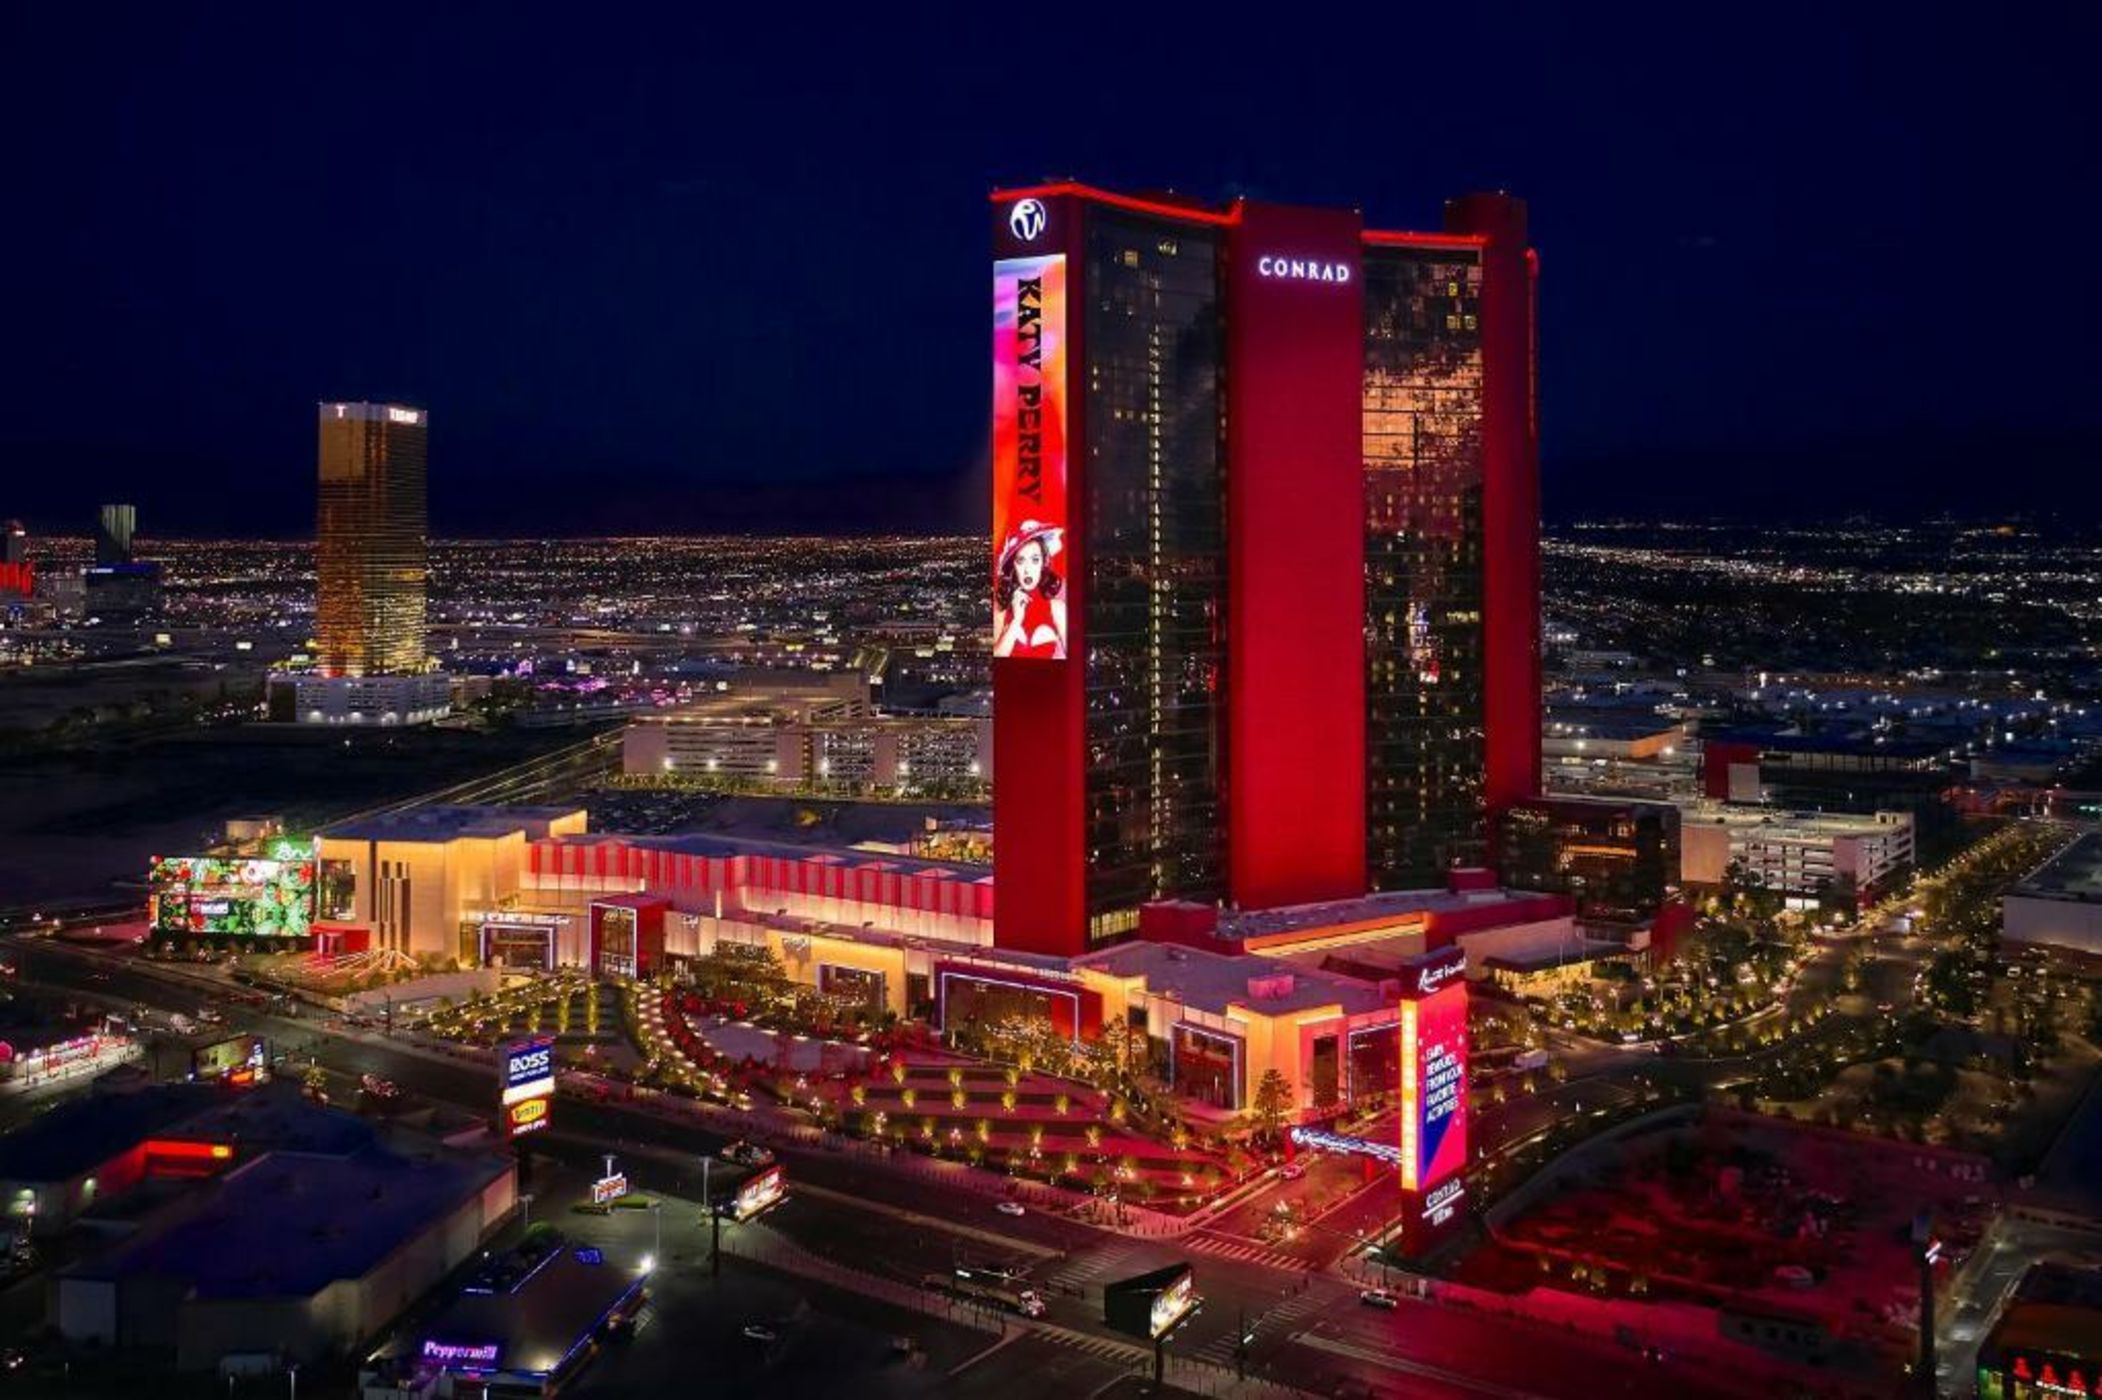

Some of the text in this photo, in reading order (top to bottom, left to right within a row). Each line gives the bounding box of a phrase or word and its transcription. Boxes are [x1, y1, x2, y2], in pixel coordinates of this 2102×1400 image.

[1259, 257, 1350, 282] CONRAD
[1017, 277, 1042, 504] KATY PERRY
[509, 1049, 550, 1074] ROSS
[424, 1341, 498, 1360] Peppermill
